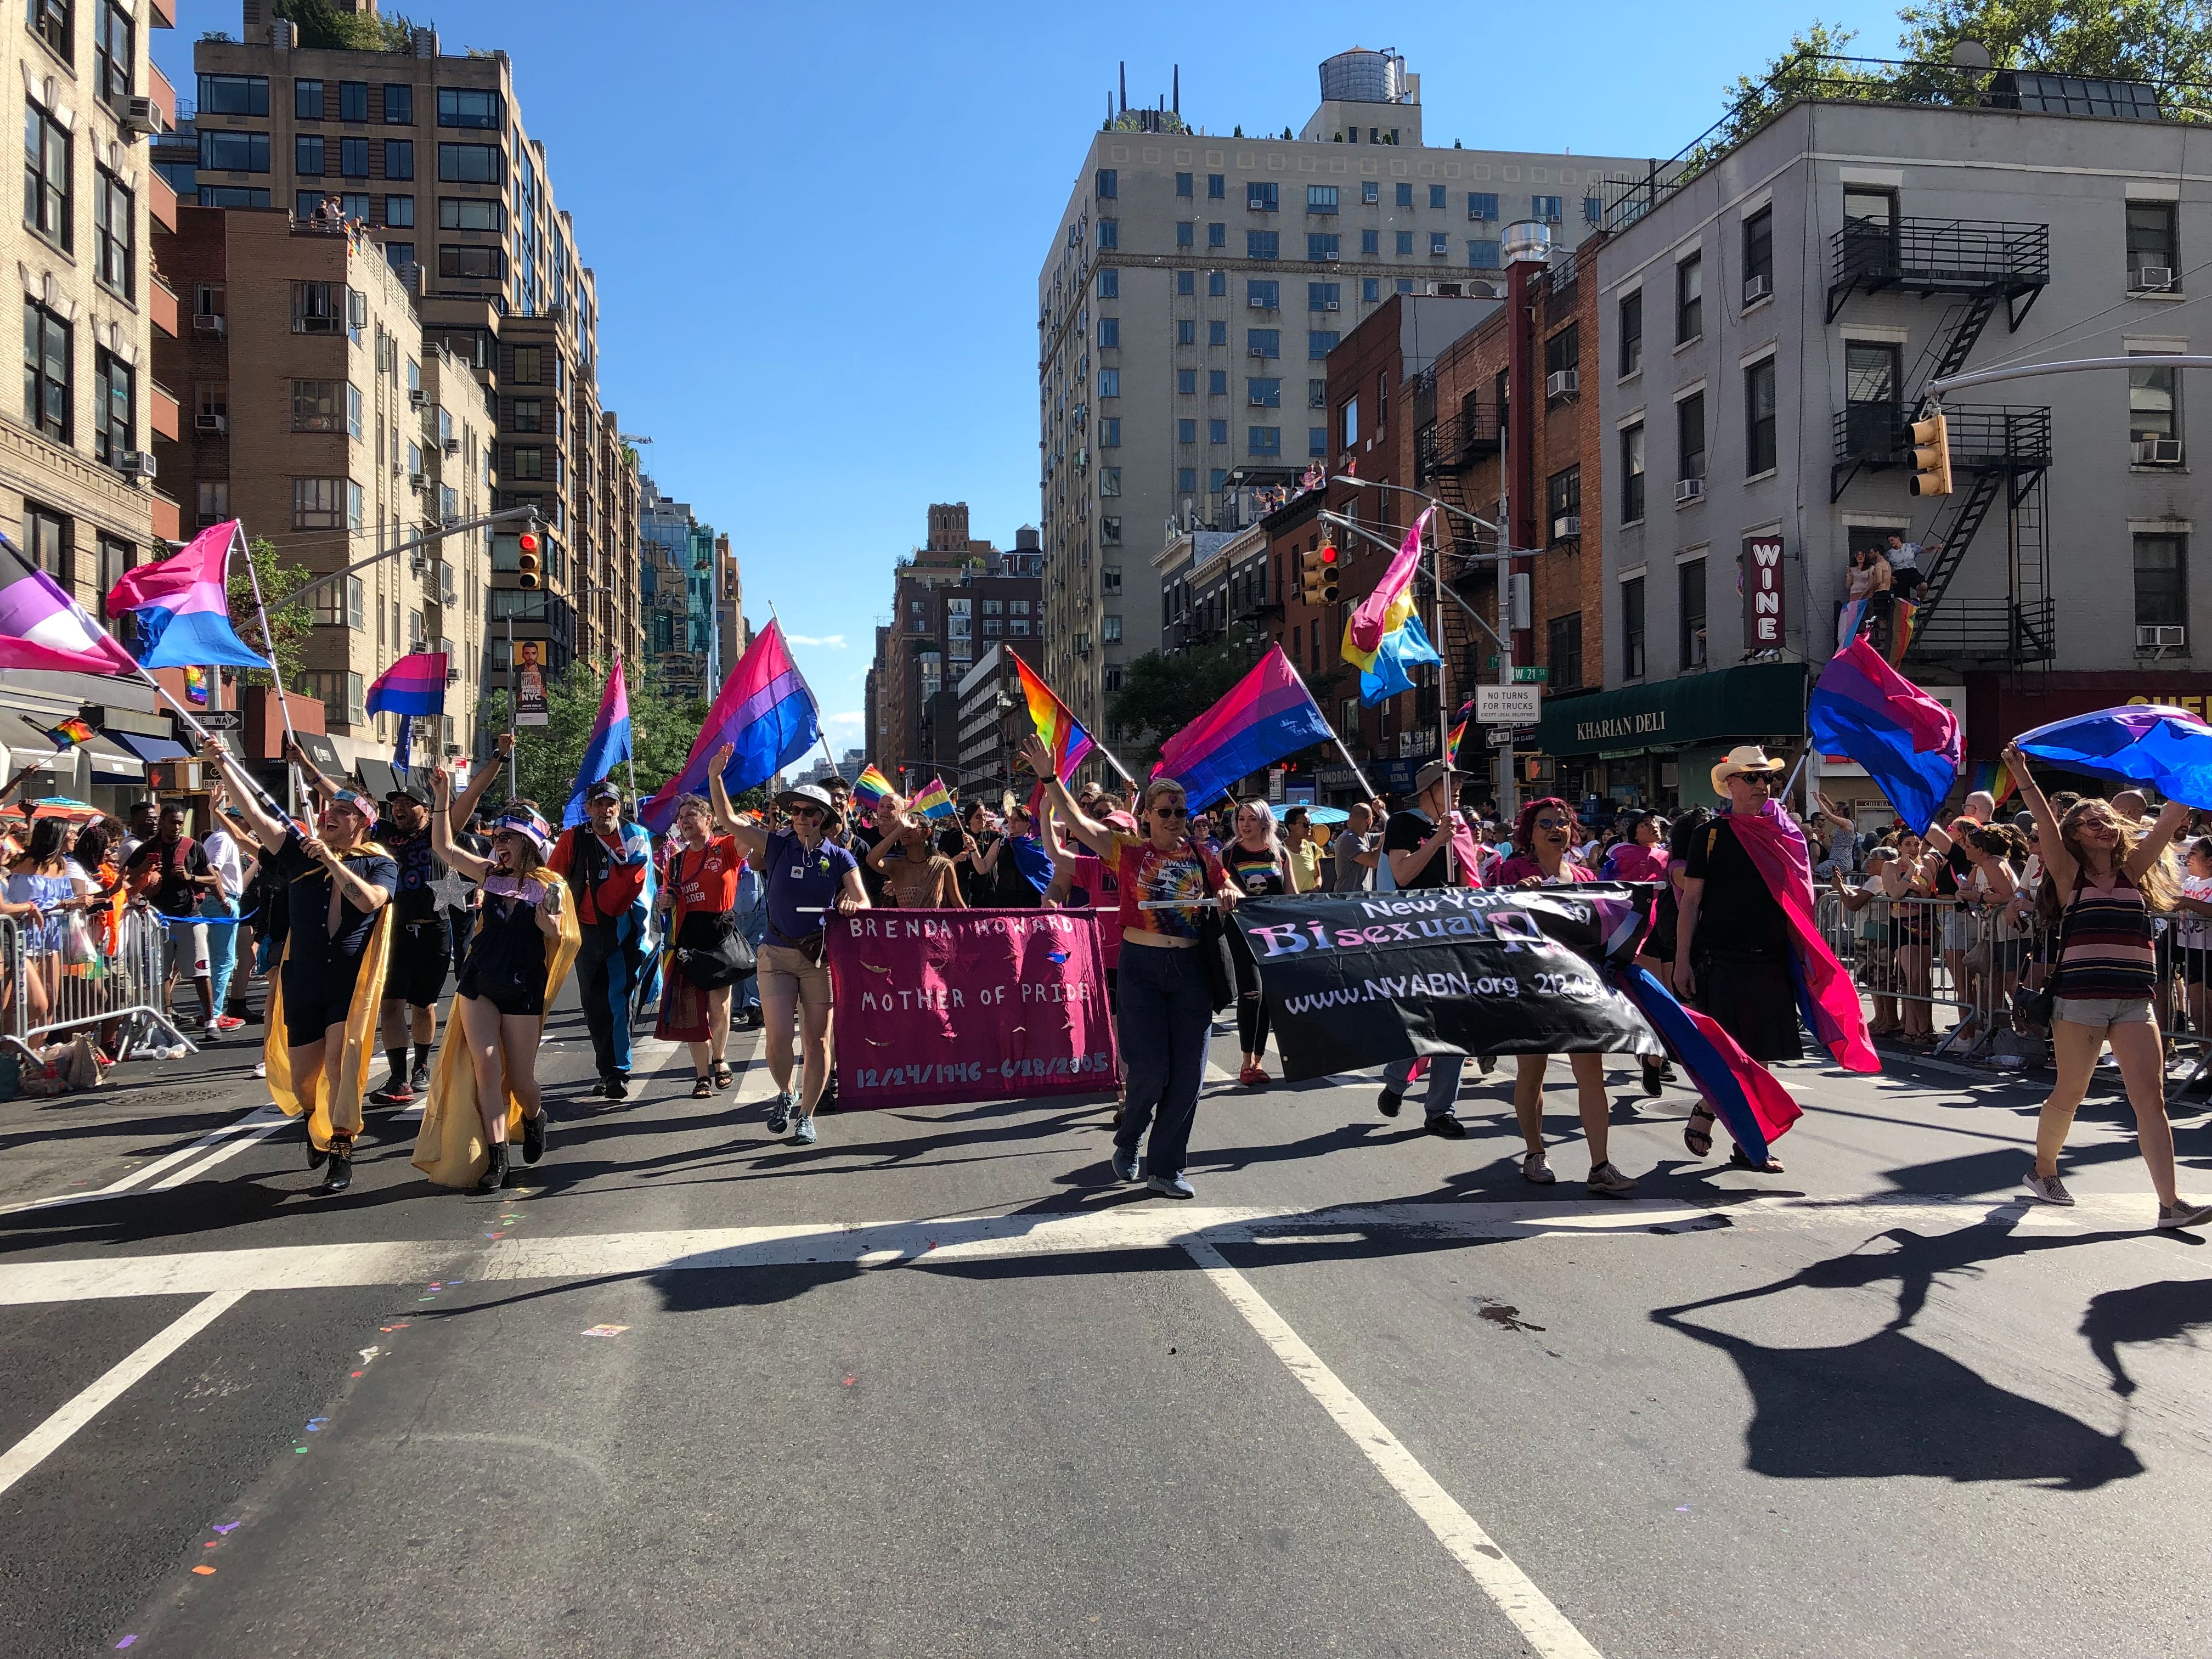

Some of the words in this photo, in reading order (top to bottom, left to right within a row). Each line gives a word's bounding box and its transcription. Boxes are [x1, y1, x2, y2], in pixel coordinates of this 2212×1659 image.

[1753, 544, 1780, 640] WINE
[1515, 669, 1523, 679] W
[1527, 668, 1536, 679] 21
[1577, 716, 1632, 741] KHARIAN
[1635, 711, 1666, 733] DELI
[1392, 763, 1405, 771] SHOE
[1390, 773, 1409, 782] REPAIR
[1586, 804, 1595, 813] ICE
[408, 850, 431, 866] SO
[1164, 889, 1195, 900] WORLDPRIDE
[1361, 899, 1436, 918] New
[850, 918, 952, 939] BRENDA
[974, 916, 1073, 937] HOWARD
[1248, 909, 1492, 957] Bisexual
[861, 988, 965, 1012] MOTHER
[980, 985, 1005, 1005] OF
[1022, 982, 1090, 1003] PRIDE
[1285, 972, 1519, 1015] www.NYABN.org
